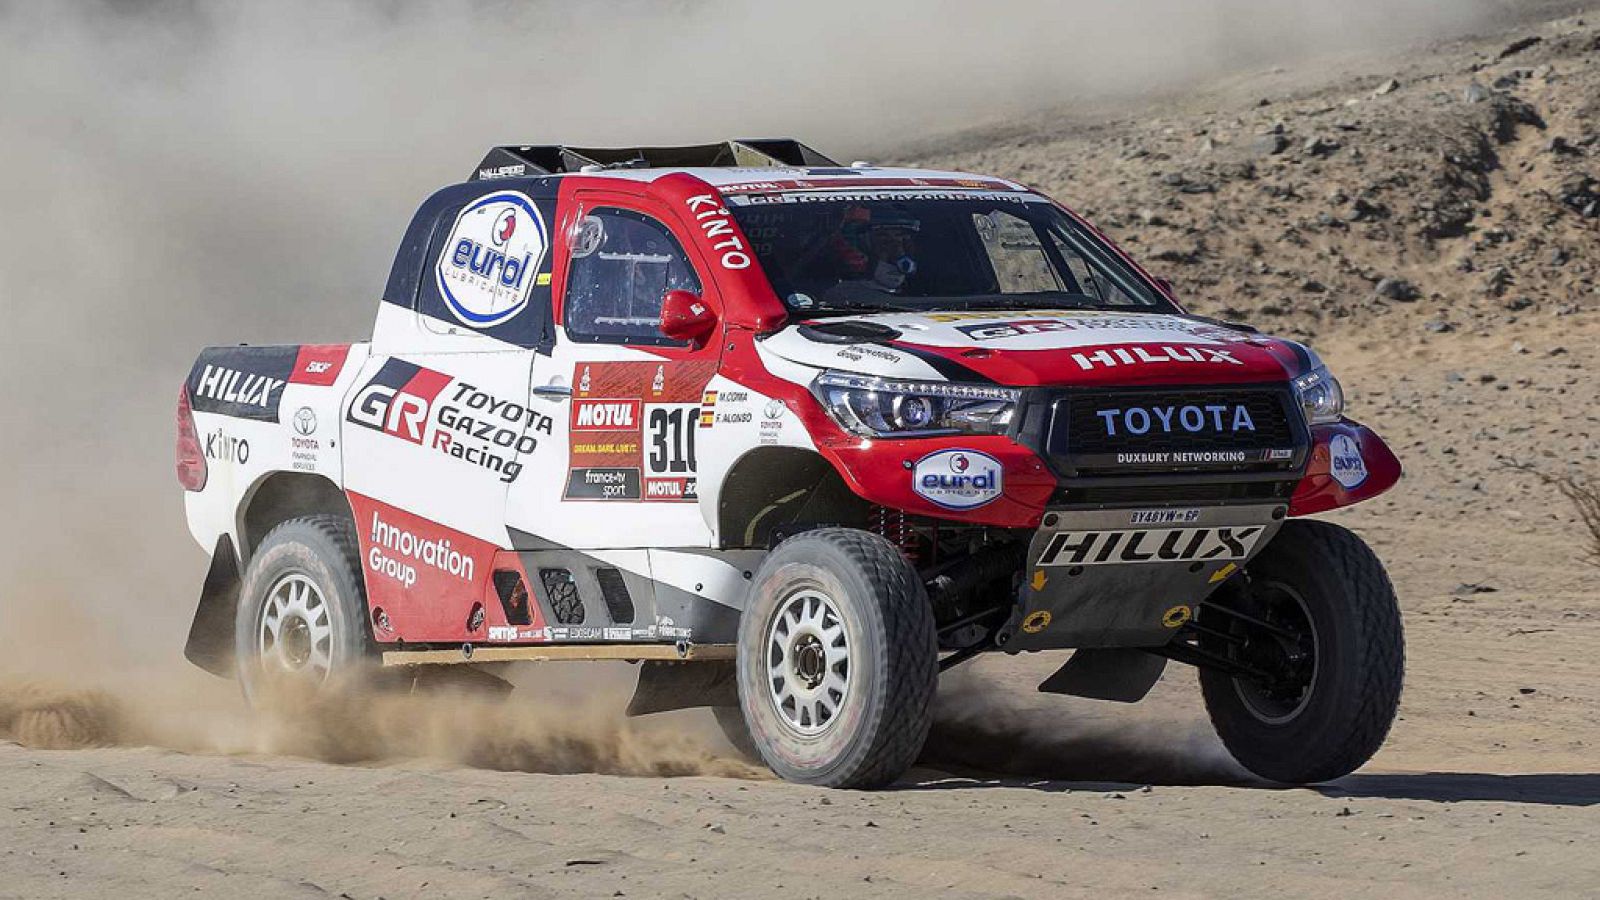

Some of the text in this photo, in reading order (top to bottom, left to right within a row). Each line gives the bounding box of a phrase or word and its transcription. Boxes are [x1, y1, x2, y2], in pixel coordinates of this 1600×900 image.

[452, 237, 533, 291] eurol
[305, 361, 333, 373] SKF
[1071, 347, 1244, 370] HILUX
[196, 364, 286, 408] HILUX
[350, 383, 430, 441] GR
[452, 382, 553, 435] TOYOTA
[576, 403, 633, 426] MOTUL
[1097, 405, 1256, 436] TOYOTA
[291, 437, 319, 450] TOYOTA
[438, 406, 537, 454] GAZOO
[432, 428, 523, 484] Racing
[1118, 451, 1246, 463] DUXBURY NETWORKING
[602, 484, 626, 499] sport
[647, 480, 682, 495] MOTUL
[922, 469, 996, 489] eurol
[1040, 527, 1262, 563] HILUX
[369, 547, 416, 589] Group
